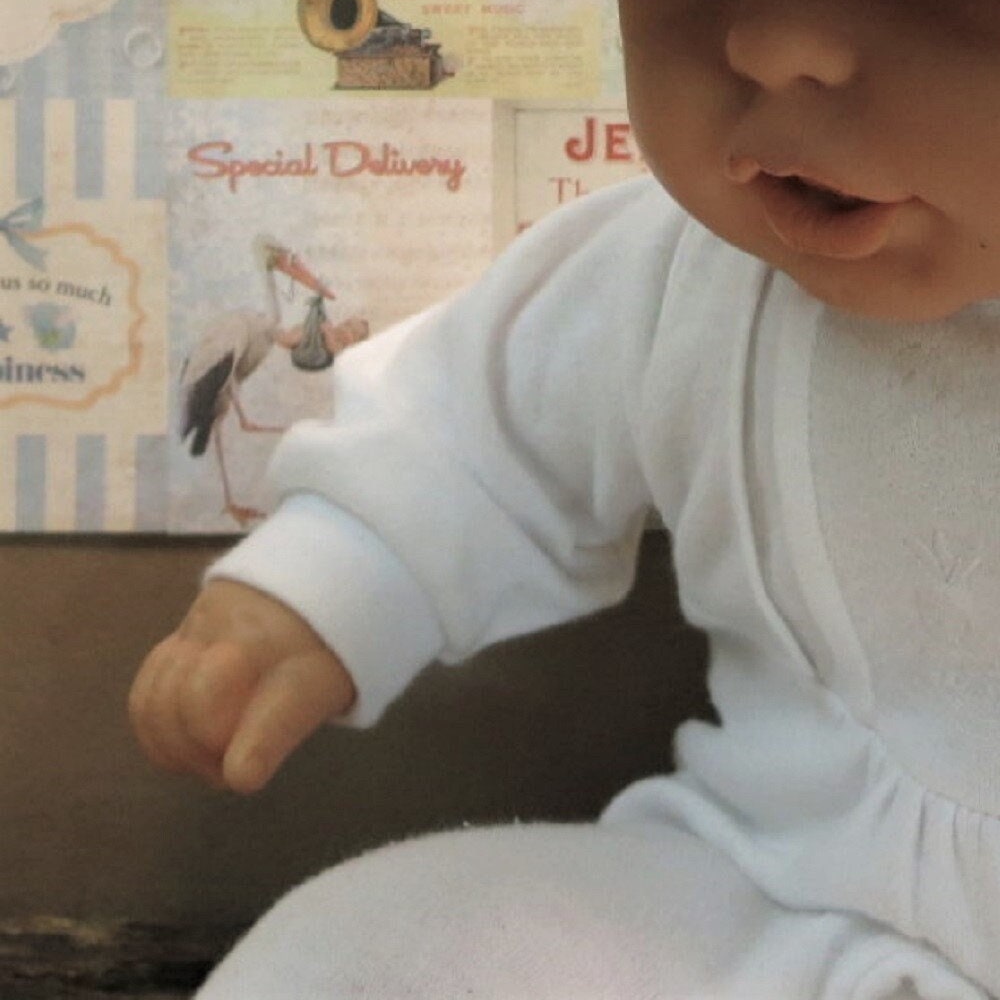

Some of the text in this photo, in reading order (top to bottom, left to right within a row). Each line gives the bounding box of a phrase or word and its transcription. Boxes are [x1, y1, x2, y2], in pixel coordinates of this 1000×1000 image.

[187, 140, 466, 194] Special Delivery
[27, 277, 52, 292] so
[55, 279, 112, 307] much
